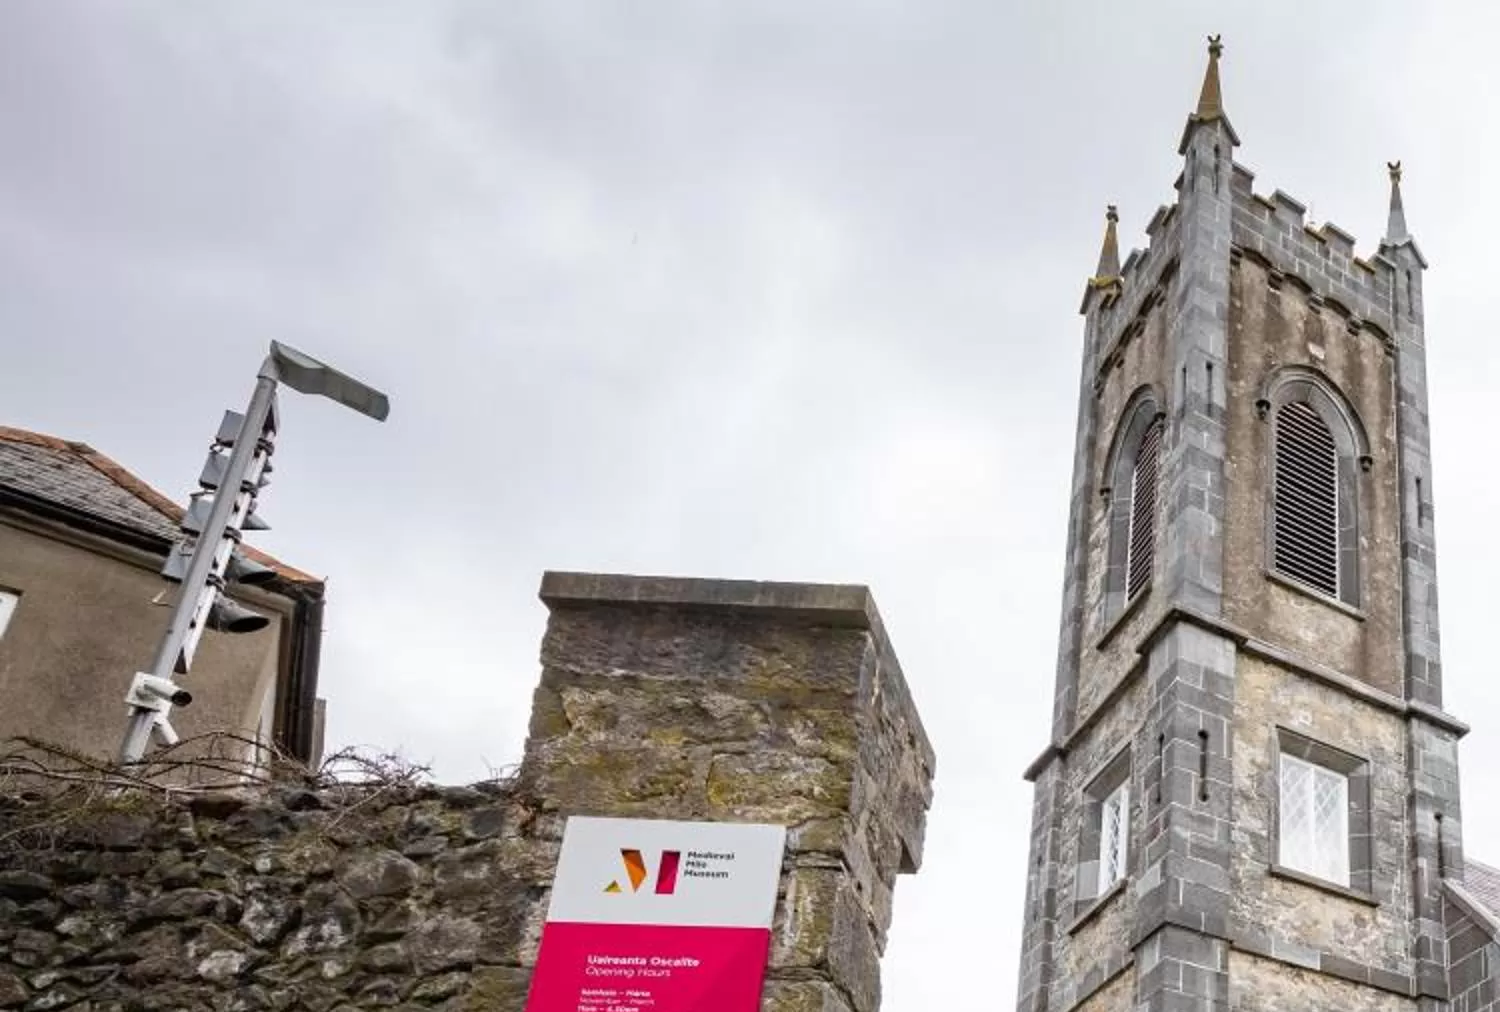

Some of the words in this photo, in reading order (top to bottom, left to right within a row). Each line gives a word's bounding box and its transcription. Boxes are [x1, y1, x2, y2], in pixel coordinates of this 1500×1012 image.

[687, 851, 735, 860] Medieval
[683, 869, 729, 879] Museum
[585, 966, 635, 978] Opening
[637, 967, 672, 978] Hours
